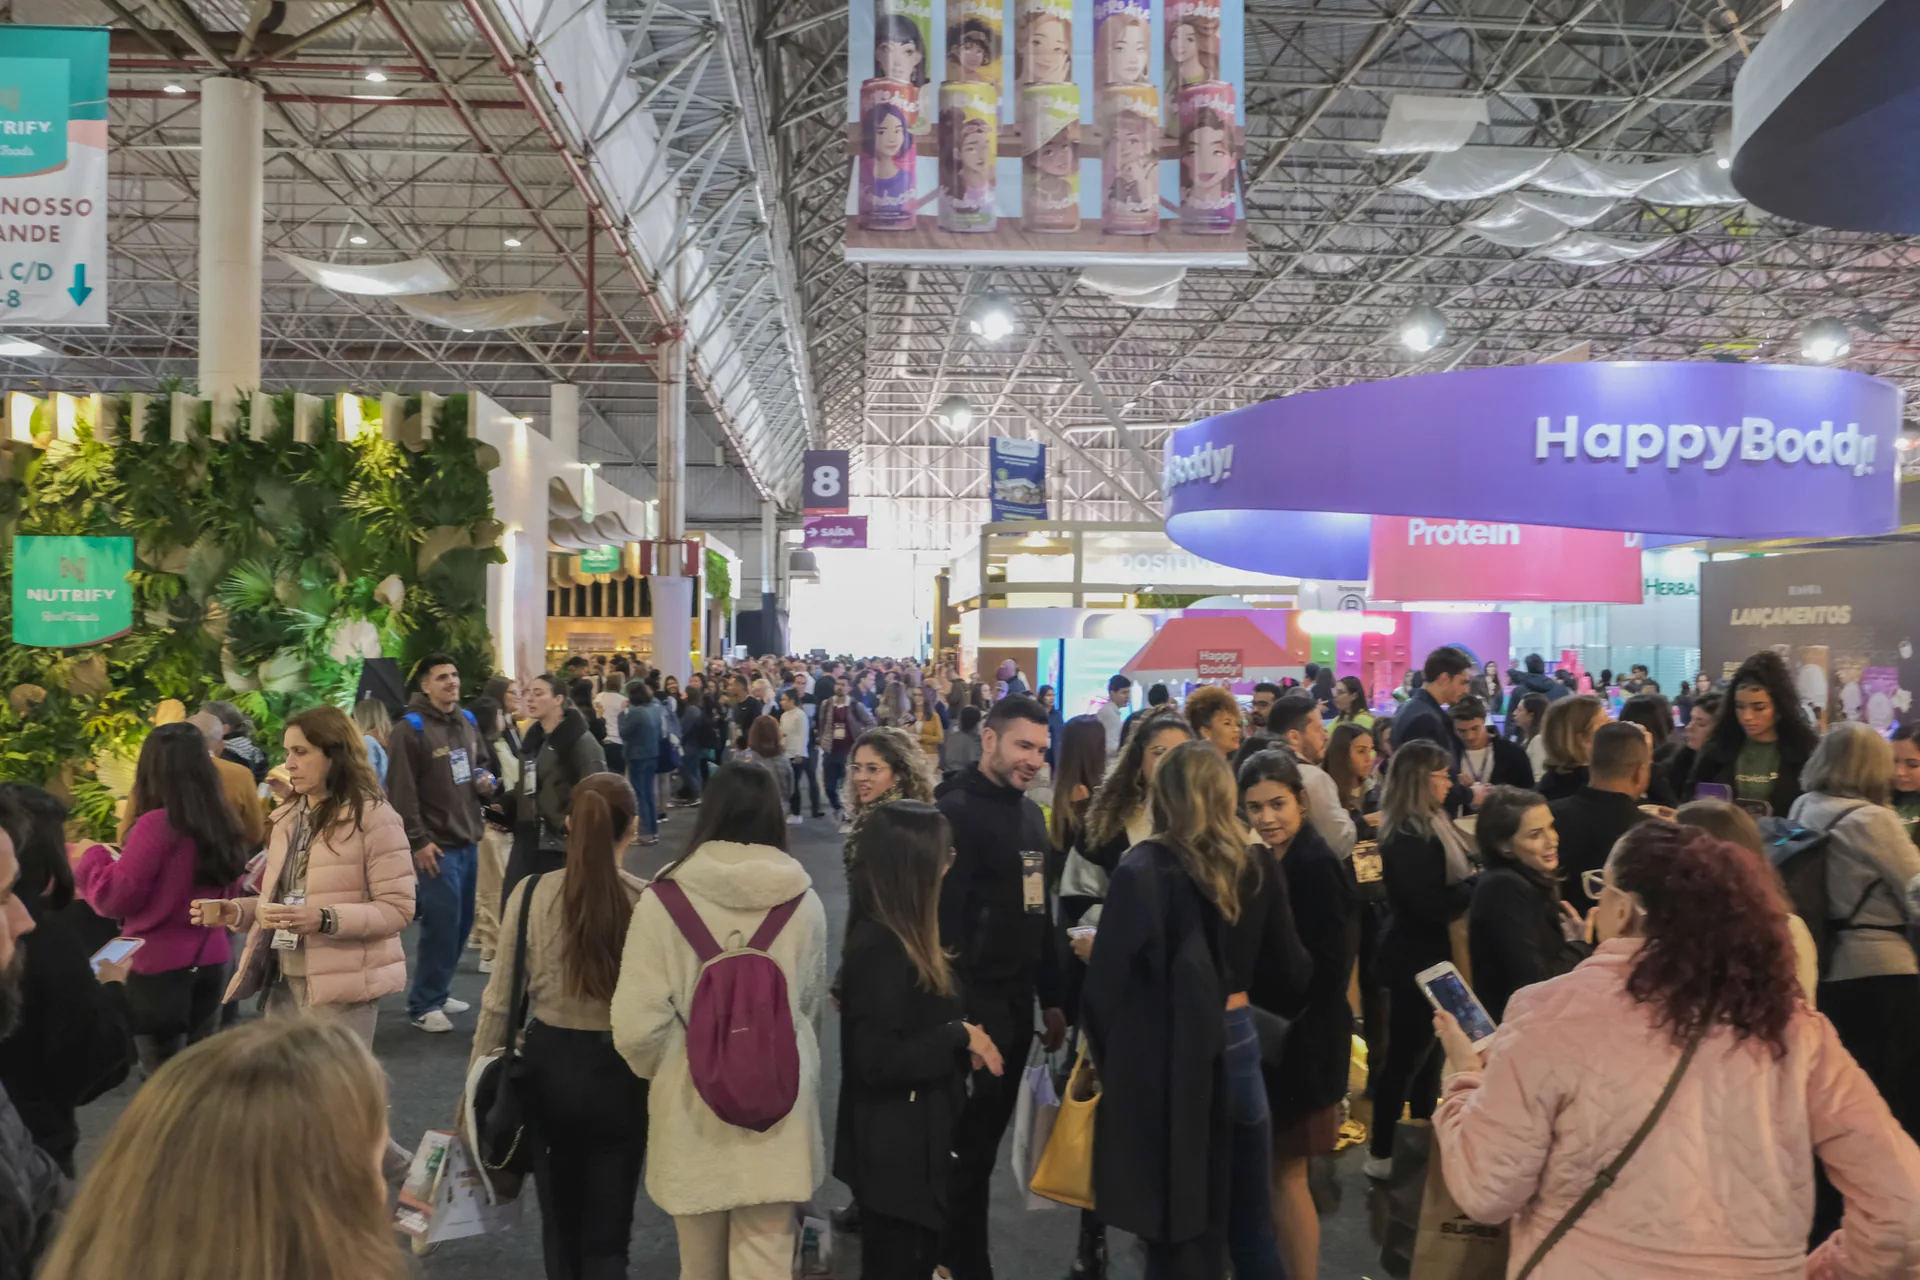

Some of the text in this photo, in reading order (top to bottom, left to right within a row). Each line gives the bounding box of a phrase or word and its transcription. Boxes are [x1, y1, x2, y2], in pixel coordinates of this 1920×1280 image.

[1, 197, 93, 217] NOSSO
[10, 260, 54, 285] C/D
[812, 465, 841, 498] 8
[820, 525, 855, 537] SAÍDA
[1408, 518, 1520, 546] Protein
[26, 588, 116, 602] NUTRIFY
[1644, 577, 1700, 595] HERBA
[1730, 605, 1852, 629] LANÇAMENTOS
[1199, 650, 1238, 663] Happy
